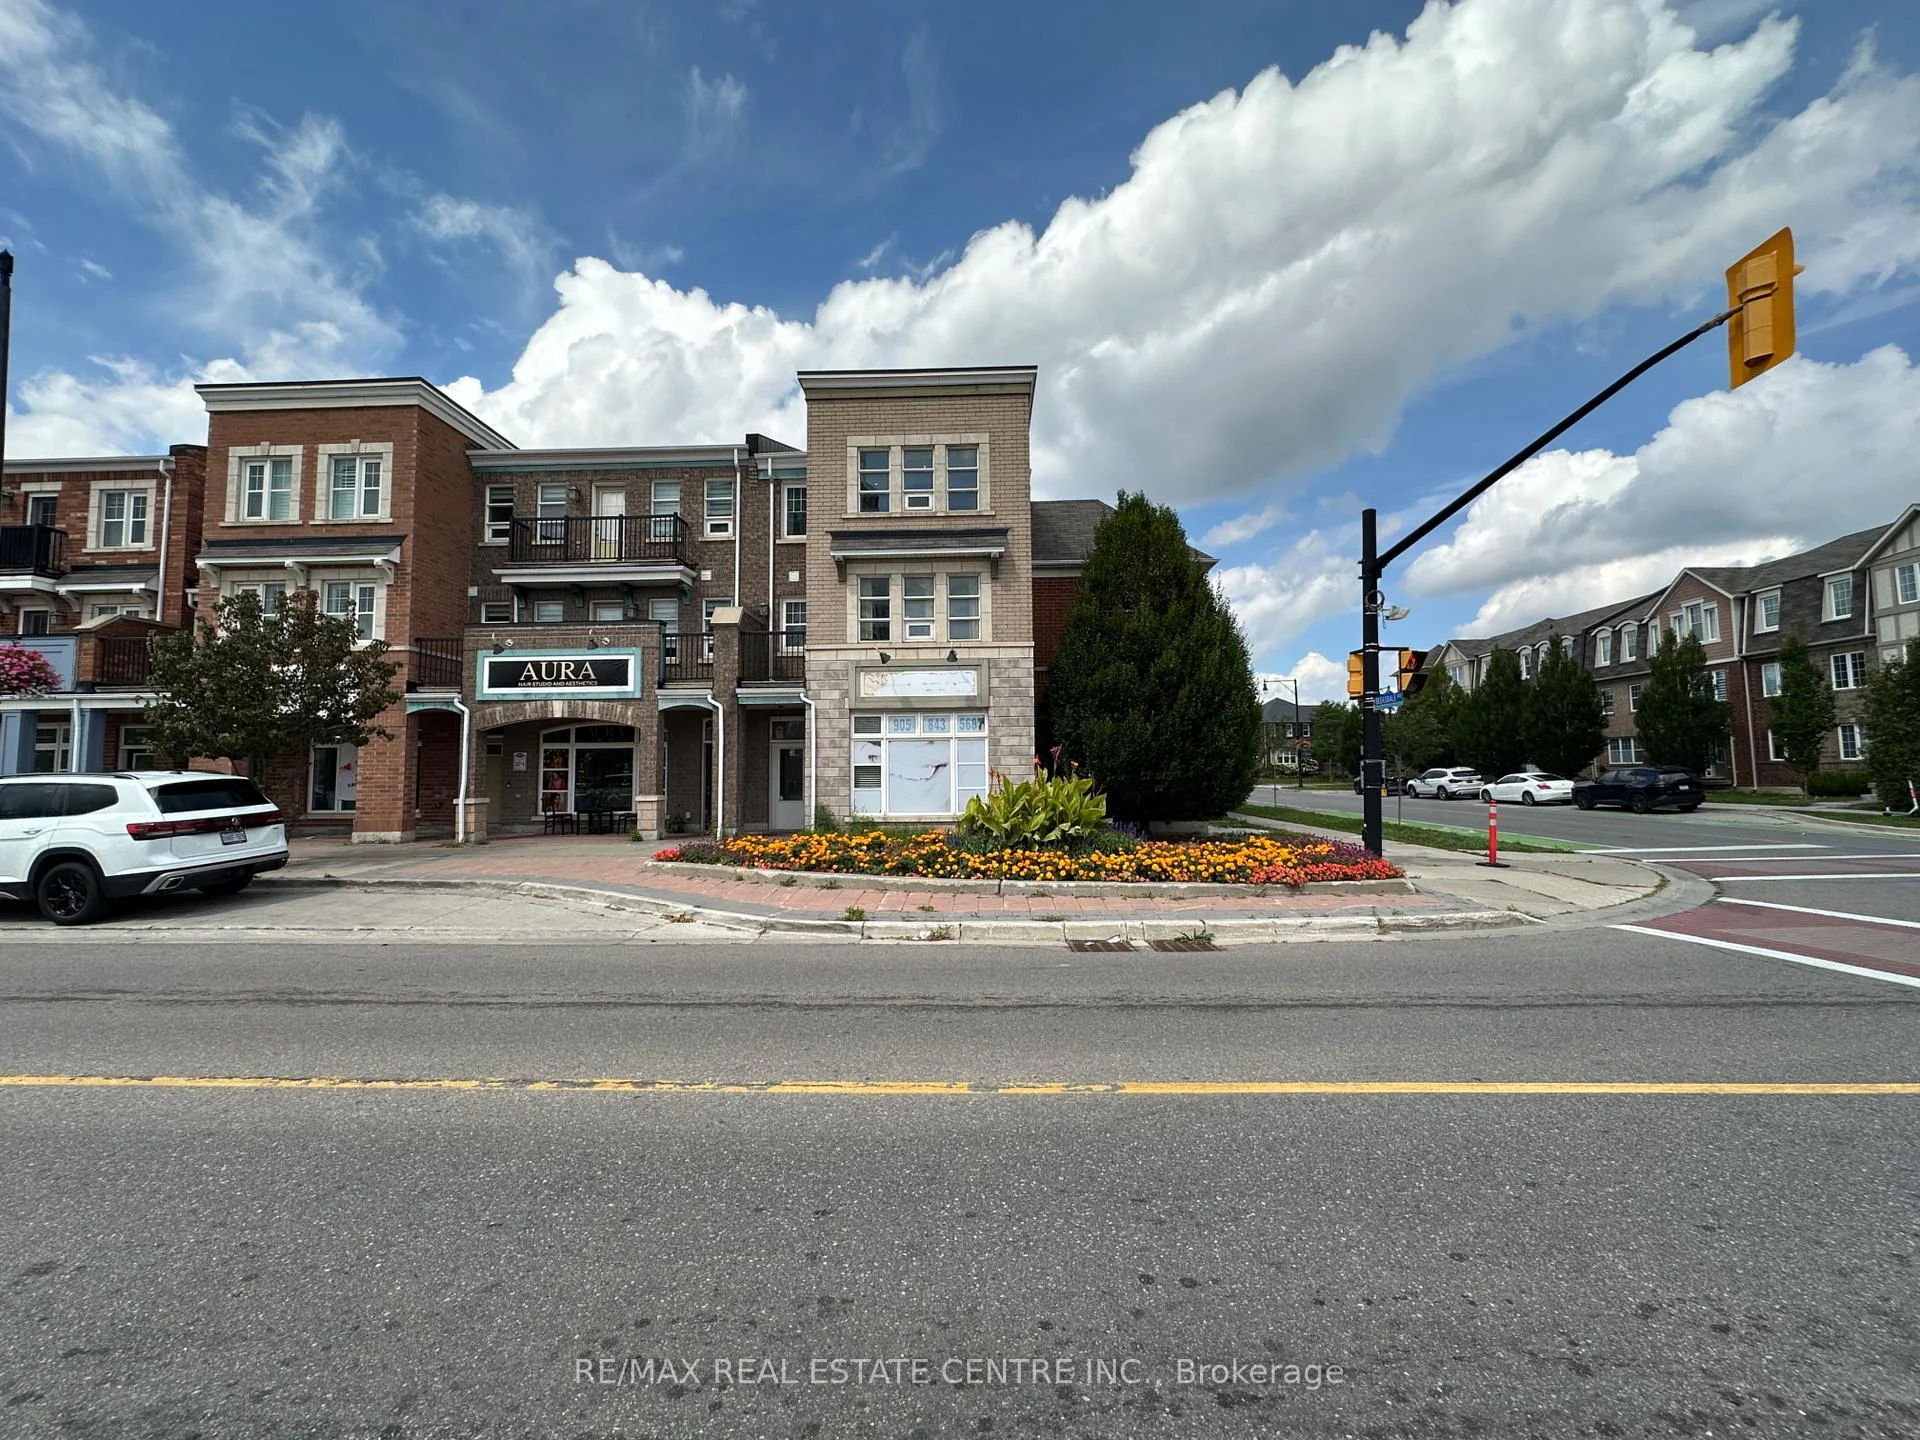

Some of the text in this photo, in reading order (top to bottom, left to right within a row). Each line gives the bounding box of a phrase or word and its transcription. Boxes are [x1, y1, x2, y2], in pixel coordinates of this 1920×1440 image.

[519, 661, 597, 681] AURA
[893, 717, 984, 731] 905 843 5687
